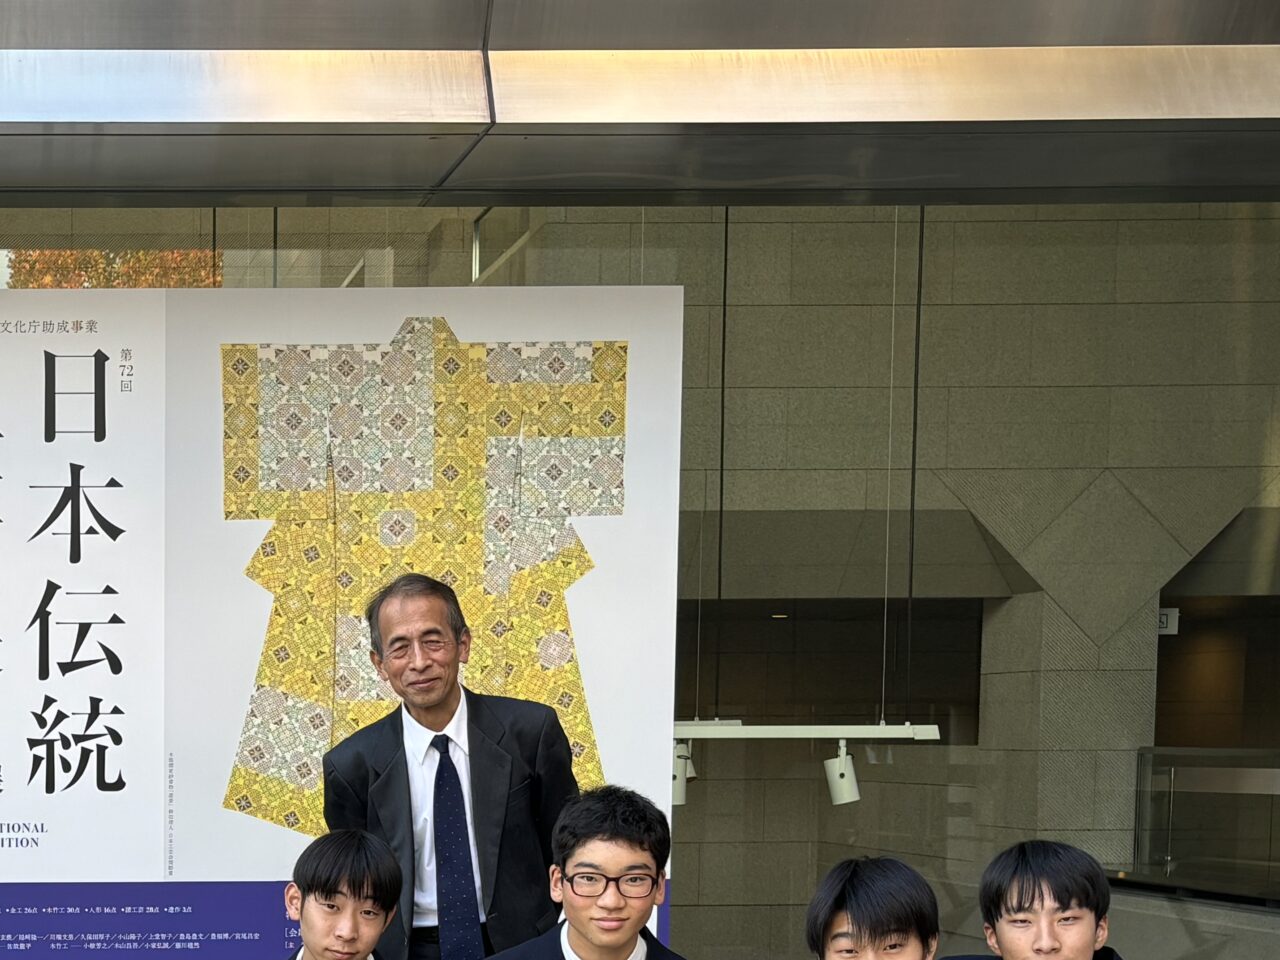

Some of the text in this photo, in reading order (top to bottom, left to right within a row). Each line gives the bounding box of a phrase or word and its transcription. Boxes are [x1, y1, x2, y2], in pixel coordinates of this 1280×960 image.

[0, 319, 99, 334] 文化庁助成事業
[118, 347, 134, 393] 第72回
[25, 348, 127, 795] 日本伝統
